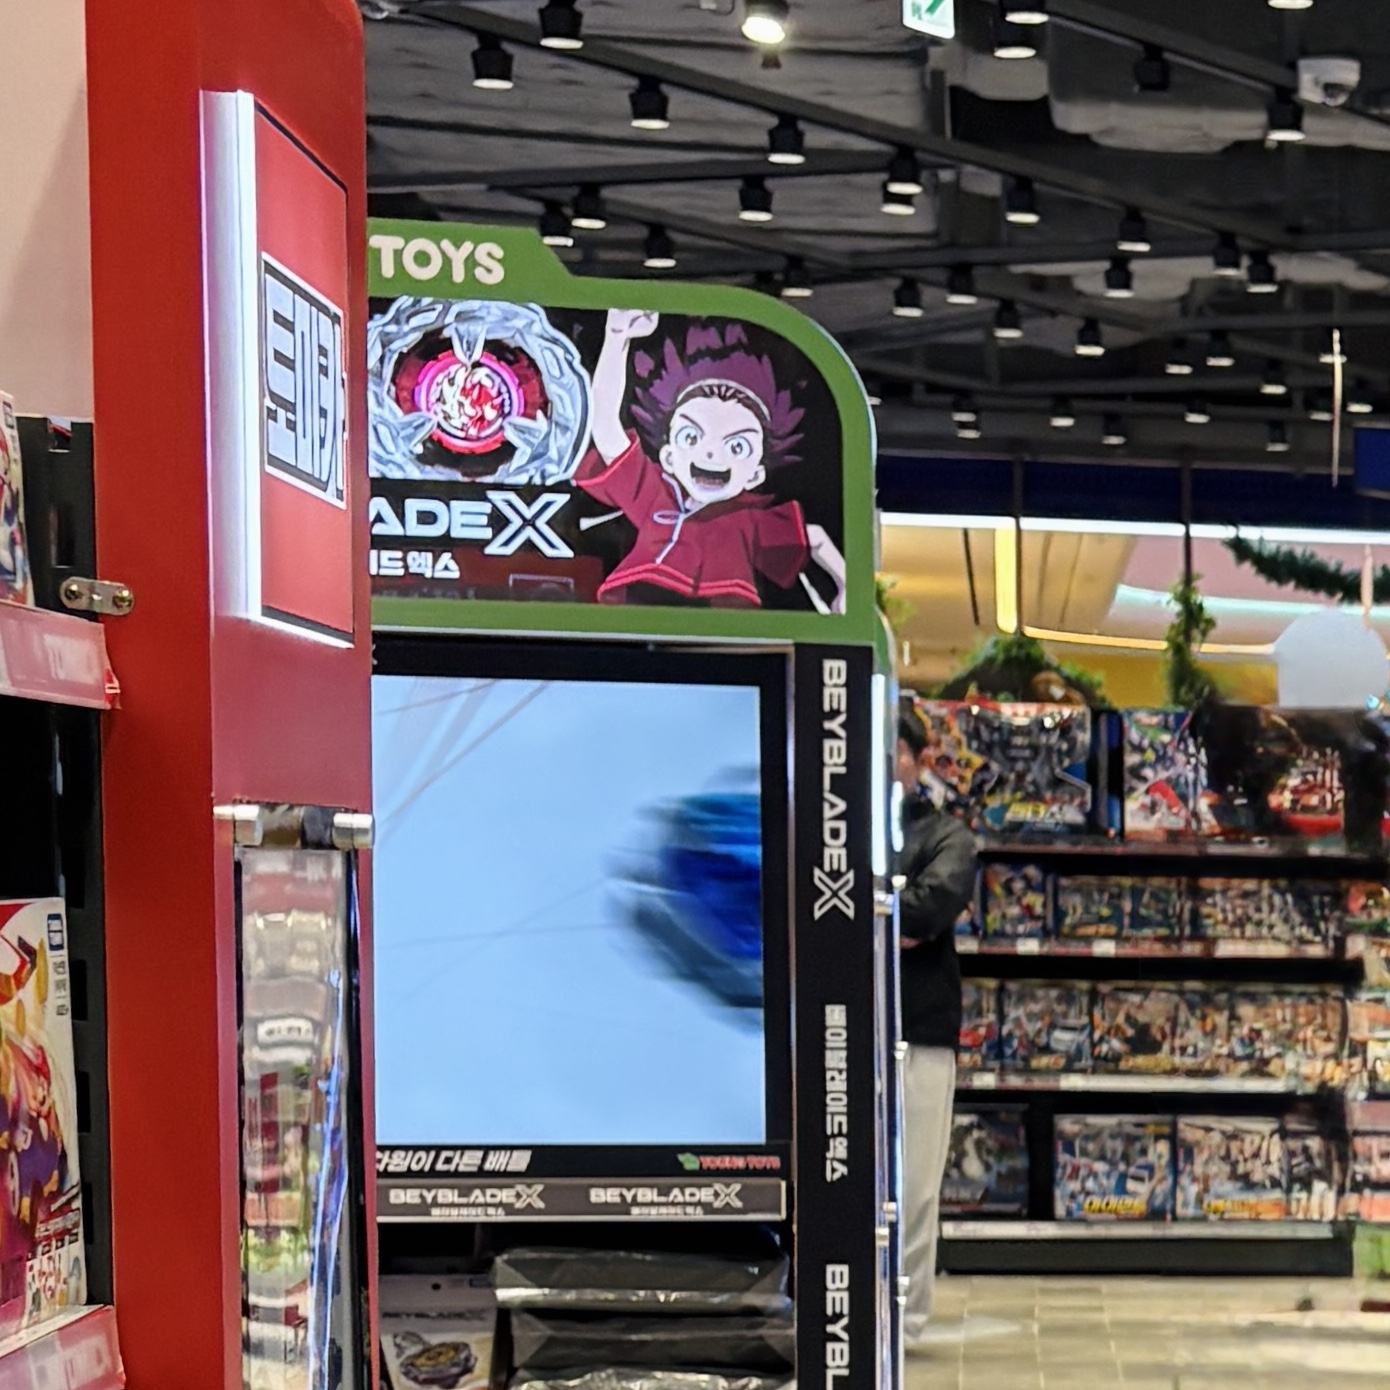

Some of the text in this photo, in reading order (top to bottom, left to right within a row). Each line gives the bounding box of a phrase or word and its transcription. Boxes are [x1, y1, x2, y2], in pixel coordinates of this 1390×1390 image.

[369, 234, 505, 285] TOYS
[812, 658, 856, 920] BEYBLADEX
[388, 1183, 545, 1210] BEYBLADEX
[589, 1182, 743, 1209] BEYBLADEX
